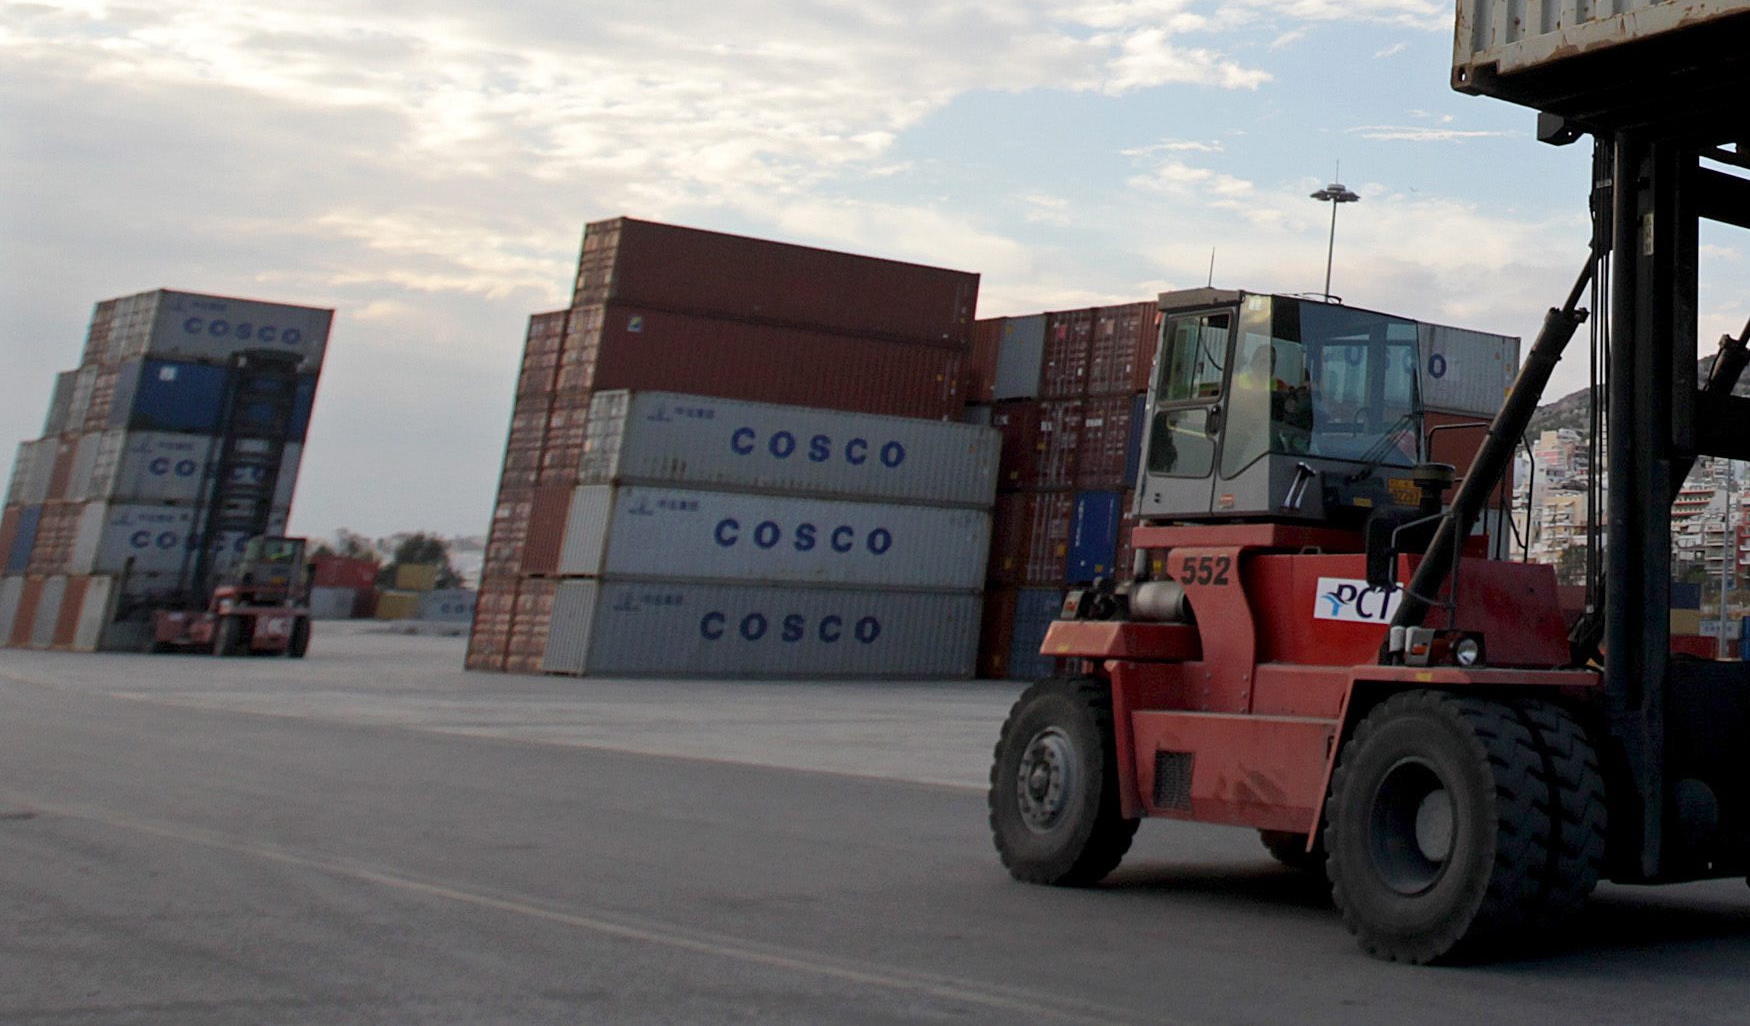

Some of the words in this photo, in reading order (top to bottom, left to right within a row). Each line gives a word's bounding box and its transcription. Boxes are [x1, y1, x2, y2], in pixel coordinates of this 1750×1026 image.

[183, 317, 301, 346] COSCO
[731, 427, 906, 469] COSCO
[713, 518, 893, 556] COSCO
[1180, 555, 1230, 587] 552
[1328, 583, 1403, 620] PCT
[699, 610, 882, 645] COSCO
